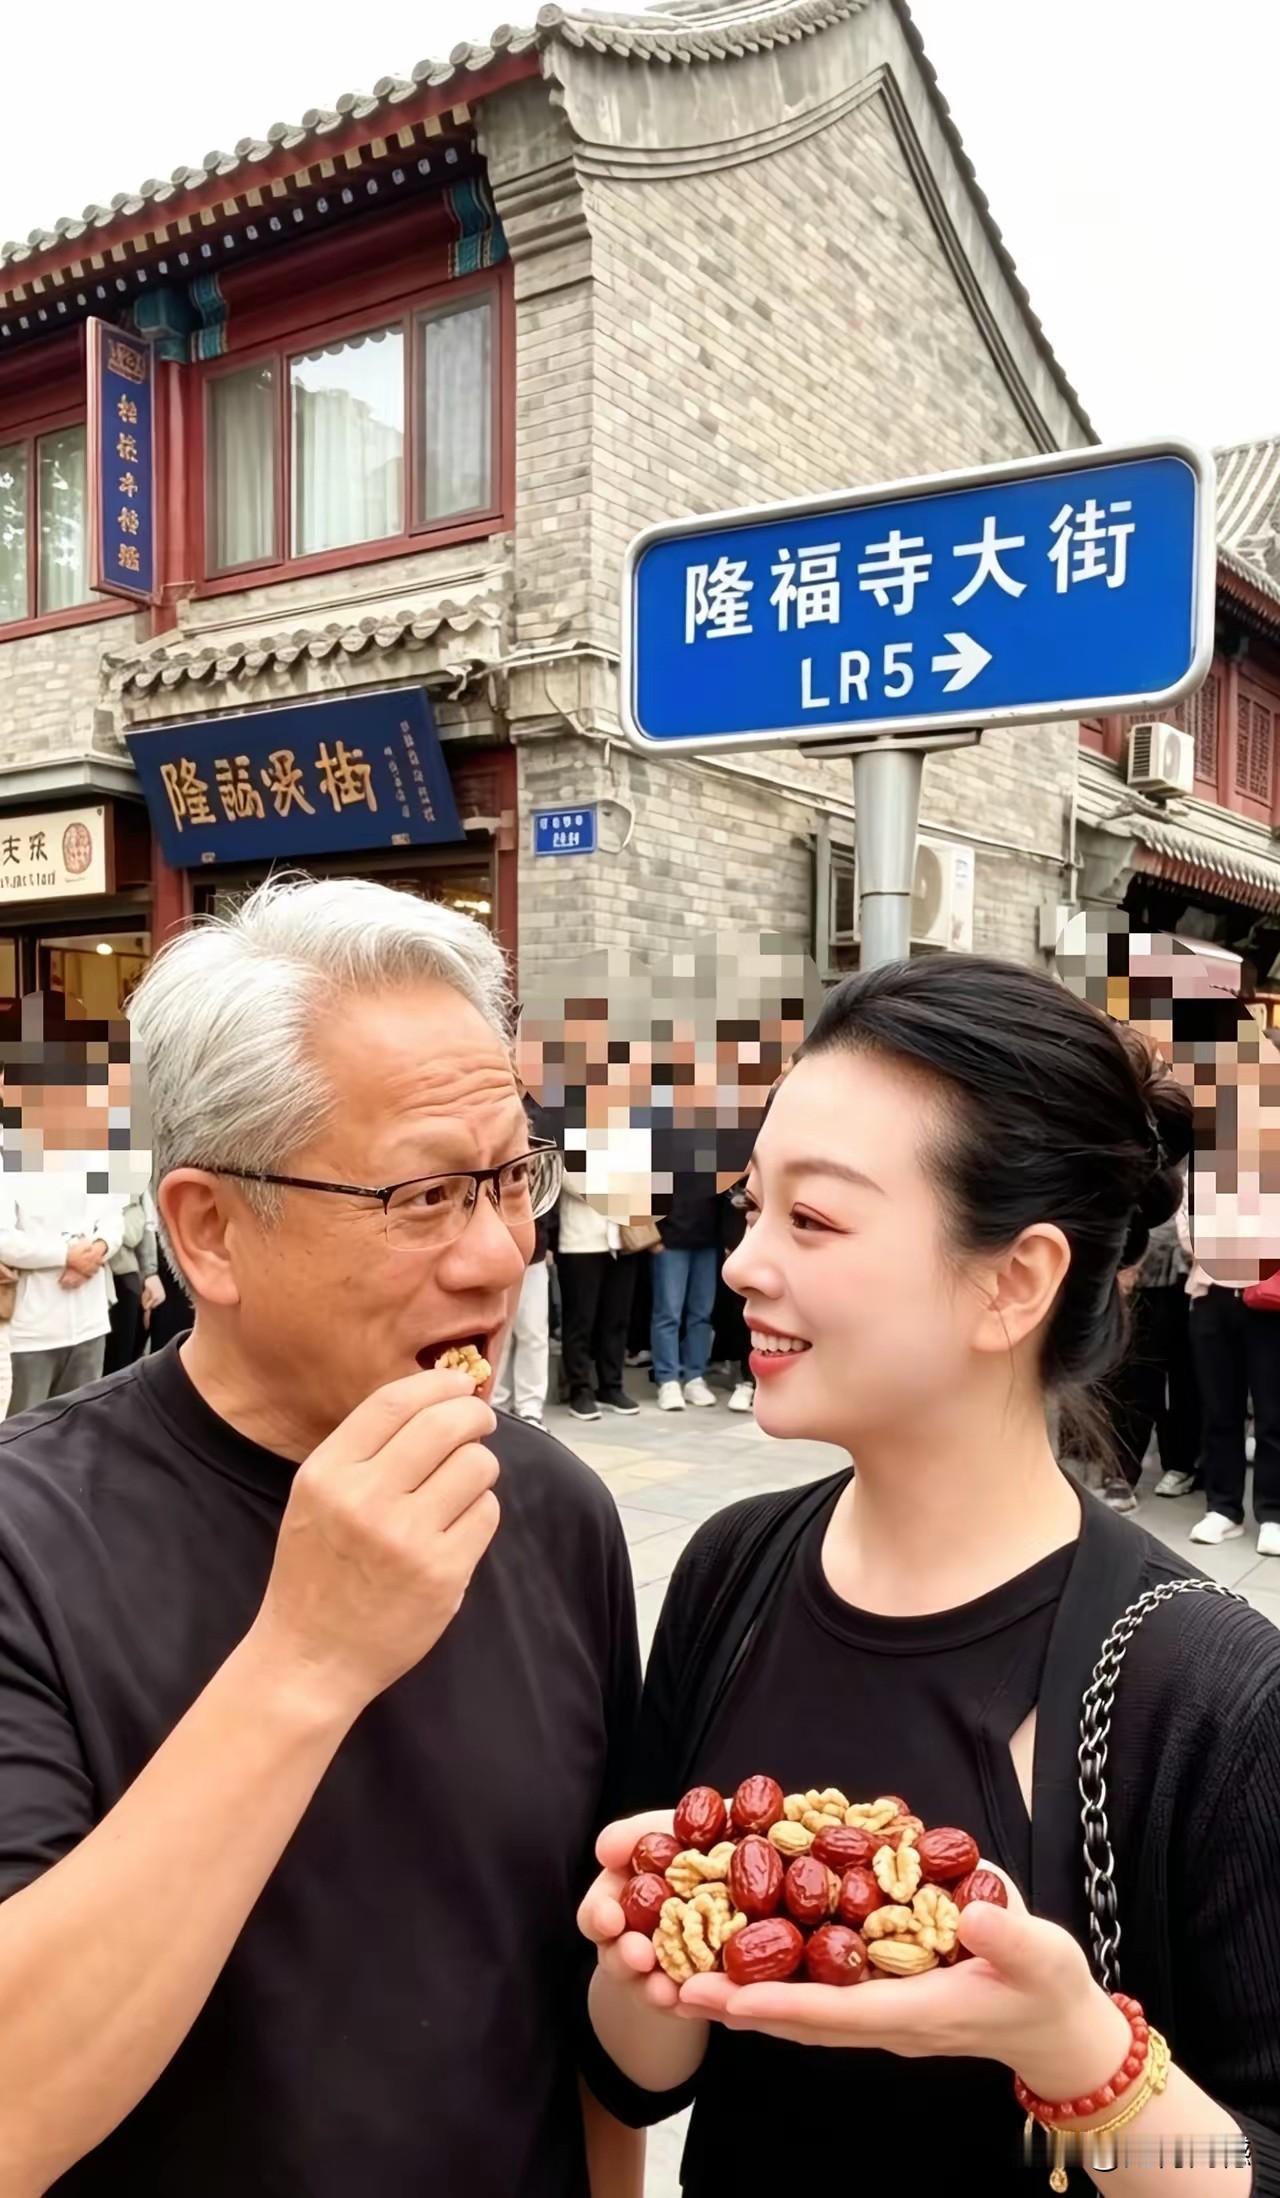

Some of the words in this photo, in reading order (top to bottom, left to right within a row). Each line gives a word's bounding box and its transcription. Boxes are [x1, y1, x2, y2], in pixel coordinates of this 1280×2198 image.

[686, 500, 1136, 644] 隆福寺大街
[801, 642, 914, 709] LR5
